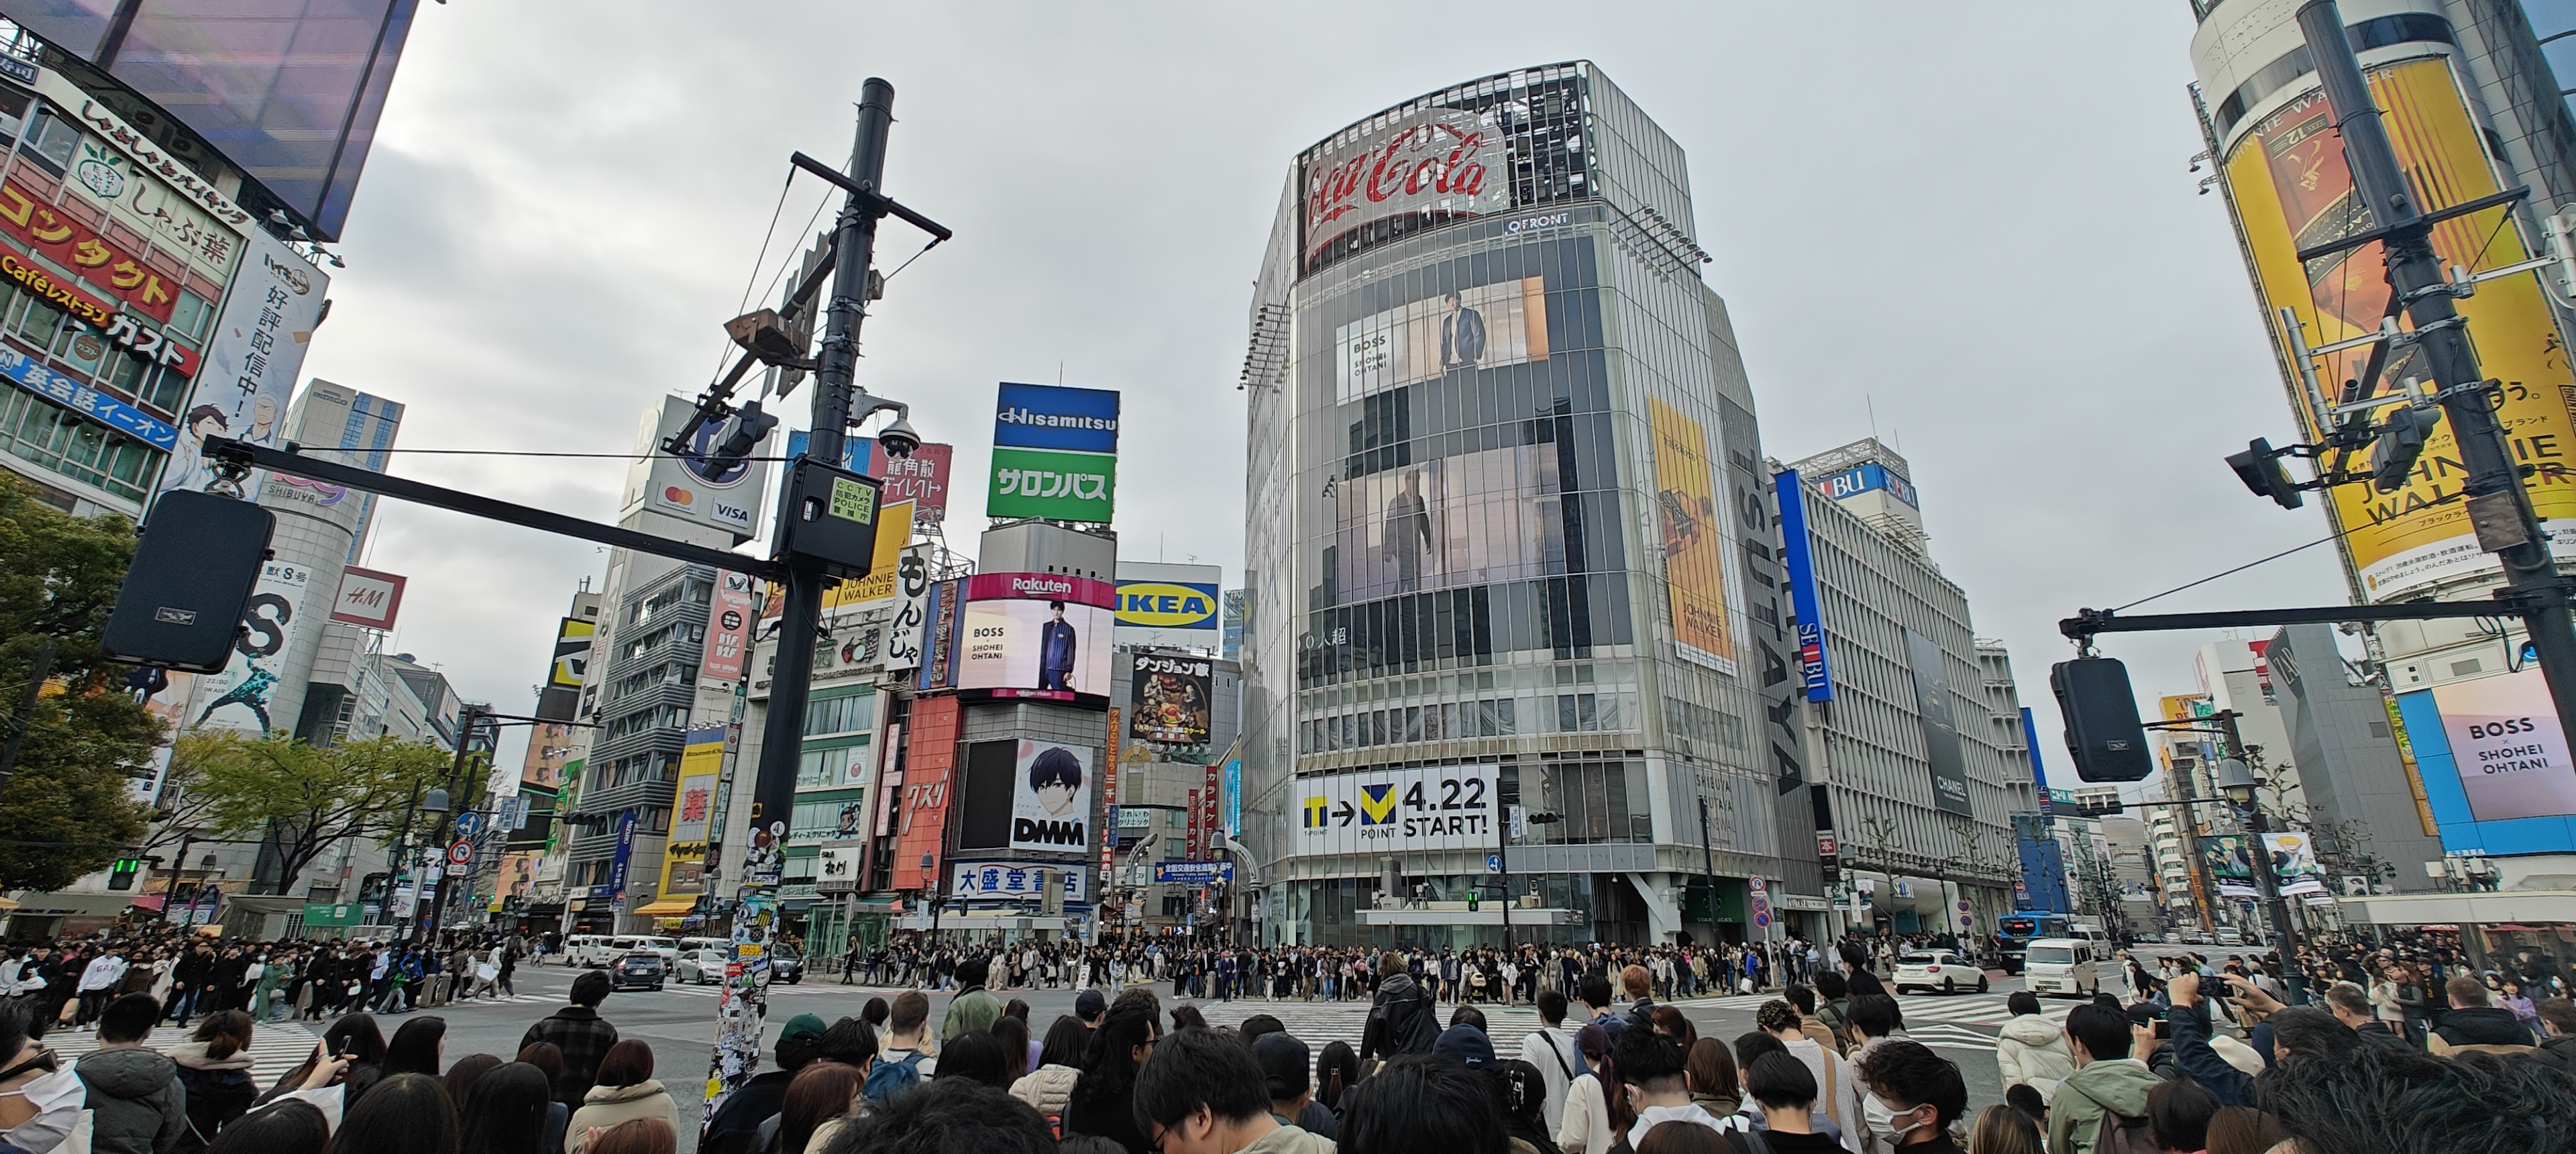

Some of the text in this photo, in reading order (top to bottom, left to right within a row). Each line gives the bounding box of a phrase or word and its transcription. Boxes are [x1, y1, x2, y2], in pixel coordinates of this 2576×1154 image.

[82, 99, 254, 225] しゃぶしゃぶバイキング
[133, 182, 231, 264] しゃぶ葉
[1508, 212, 1569, 233] QFRONT
[0, 185, 168, 305] コンタクト
[2, 255, 107, 323] Caféレストラン
[106, 311, 185, 366] ガスト
[1354, 335, 1386, 354] BOSS
[235, 285, 289, 418] 好評配信中!
[23, 364, 175, 443] 英会話イーオン
[998, 407, 1116, 431] Hisamitsu
[268, 484, 315, 504] SHIBUYA
[837, 481, 872, 496] CCTV
[998, 468, 1107, 501] サロンパス
[834, 497, 869, 513] POLICE
[836, 489, 871, 505] 防犯カメラ
[715, 503, 748, 522] VISA
[833, 505, 869, 521] 警視庁
[845, 572, 895, 590] JOHNNIE
[1012, 578, 1072, 594] Rakuten
[345, 586, 386, 609] H&M
[844, 584, 892, 601] WALKER
[890, 547, 927, 664] もんじゃ
[1116, 594, 1208, 615] IKEA
[1682, 602, 1722, 627] JOHNNIE
[973, 627, 1004, 637] BOSS
[972, 644, 1004, 652] SHOHEI
[1799, 622, 1826, 689] SEIBU
[1135, 656, 1210, 678] ダンジョン飯
[2469, 717, 2535, 740] BOSS
[1109, 710, 1118, 770] クスリのことなら
[2478, 744, 2544, 762] SHOHEI
[2483, 757, 2549, 774] OHTANI
[1403, 778, 1487, 811] 4.22
[1696, 774, 1731, 793] SHIBUYA
[1937, 775, 1967, 797] CHANEL
[682, 788, 710, 822] 薬
[902, 766, 951, 835] クスリ
[1205, 772, 1216, 822] カラオケ
[624, 819, 634, 845] MIZUHO
[1013, 817, 1085, 846] DMM
[1118, 819, 1148, 827] クリニック
[1361, 828, 1397, 839] POINT
[1404, 815, 1488, 837] START!
[1821, 839, 1833, 852] 本
[959, 868, 1079, 892] 大盛堂書店
